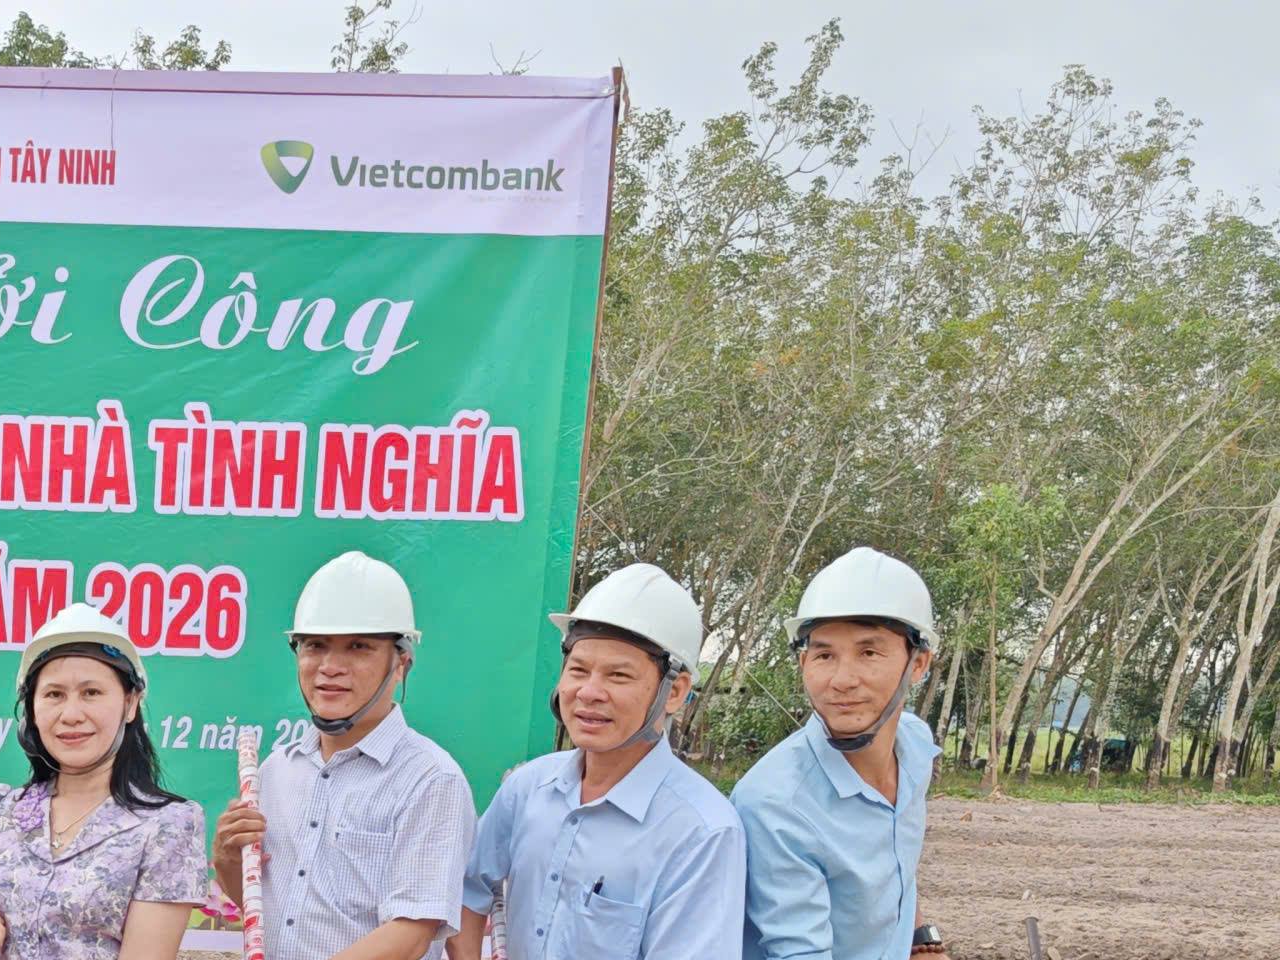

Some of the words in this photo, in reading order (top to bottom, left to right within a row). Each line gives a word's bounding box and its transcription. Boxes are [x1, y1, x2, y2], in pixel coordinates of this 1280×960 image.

[8, 139, 52, 184] TÂY
[57, 148, 117, 186] NINH
[330, 154, 566, 193] Vietcombank
[118, 253, 420, 377] Công
[151, 406, 304, 512] TÌNH
[318, 413, 521, 517] NGHĨA
[88, 566, 245, 654] 2026
[160, 715, 193, 749] 12
[199, 715, 264, 751] năm
